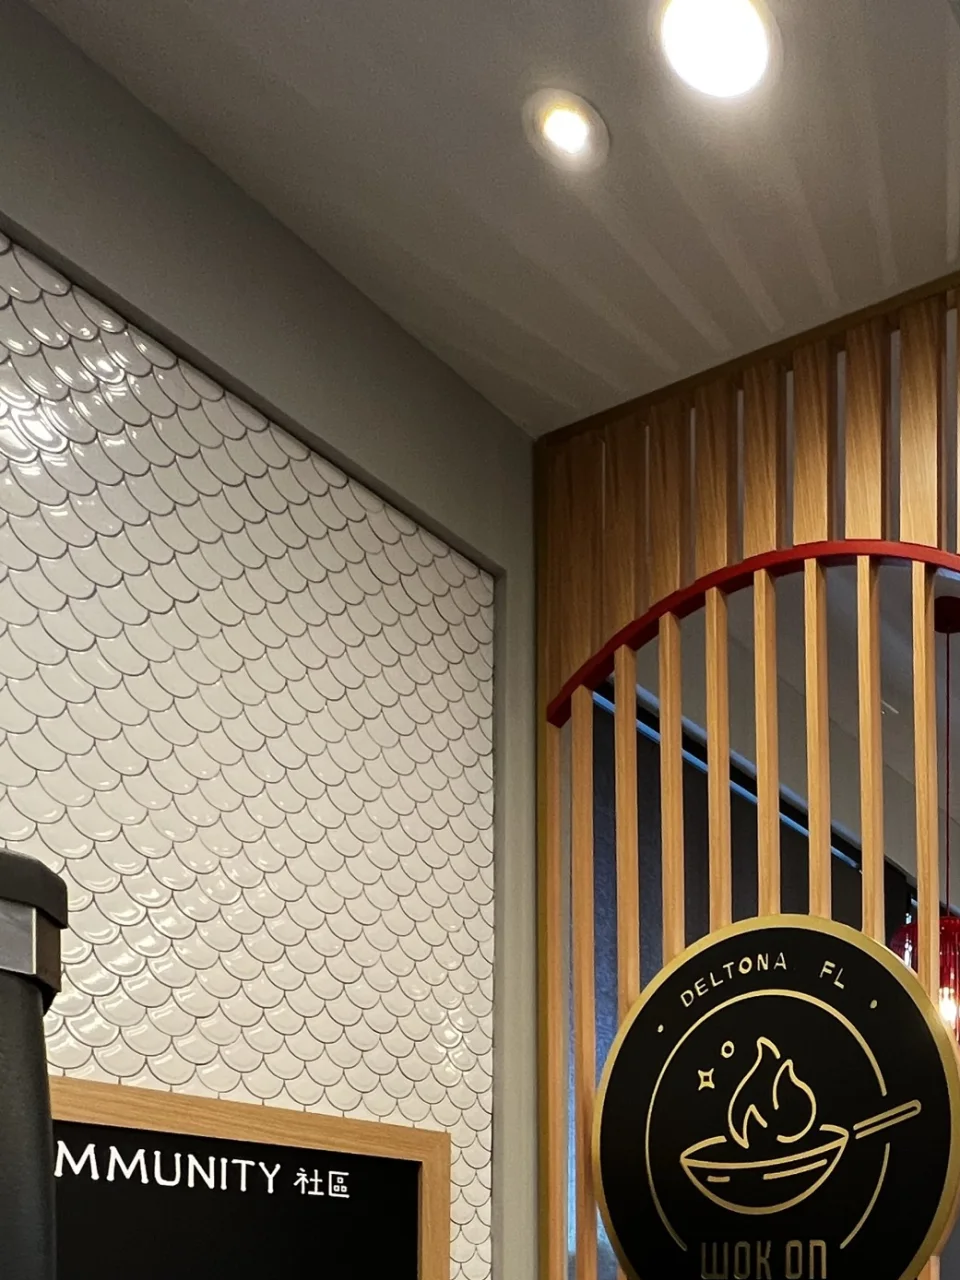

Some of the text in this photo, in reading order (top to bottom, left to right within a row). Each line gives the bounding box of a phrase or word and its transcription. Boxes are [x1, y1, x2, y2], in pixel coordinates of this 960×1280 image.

[680, 952, 845, 1008] DELTONA FL
[293, 1167, 350, 1198] 社區
